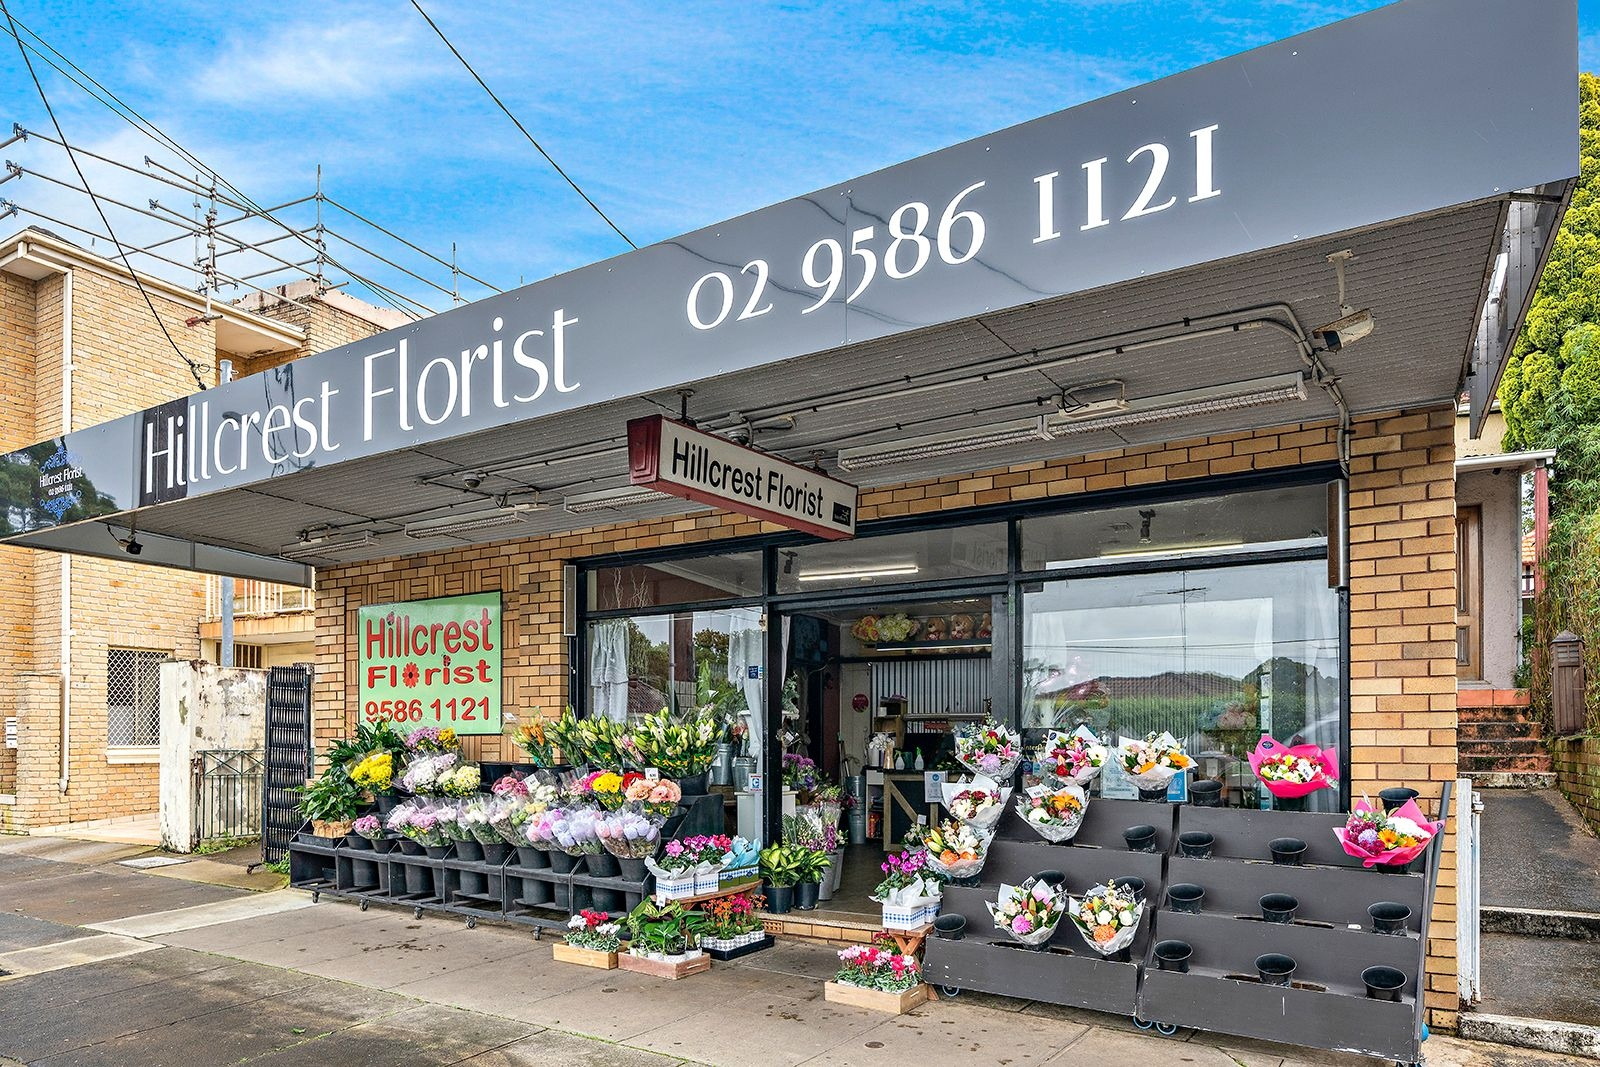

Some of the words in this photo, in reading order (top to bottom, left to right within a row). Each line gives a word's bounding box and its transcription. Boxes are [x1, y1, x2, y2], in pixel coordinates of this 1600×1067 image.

[686, 259, 774, 331] 02
[801, 180, 986, 316] 9586
[1033, 124, 1222, 244] 1121
[145, 381, 341, 493] Hillcrest
[363, 308, 581, 442] Florist
[39, 472, 63, 488] Hillcrest
[63, 466, 83, 482] Florist
[671, 437, 762, 501] Hillcrest
[767, 470, 823, 519] Florist
[366, 607, 494, 660] Hillcrest
[367, 656, 494, 690] Florist
[365, 698, 423, 723] 9586
[430, 696, 489, 722] 1121
